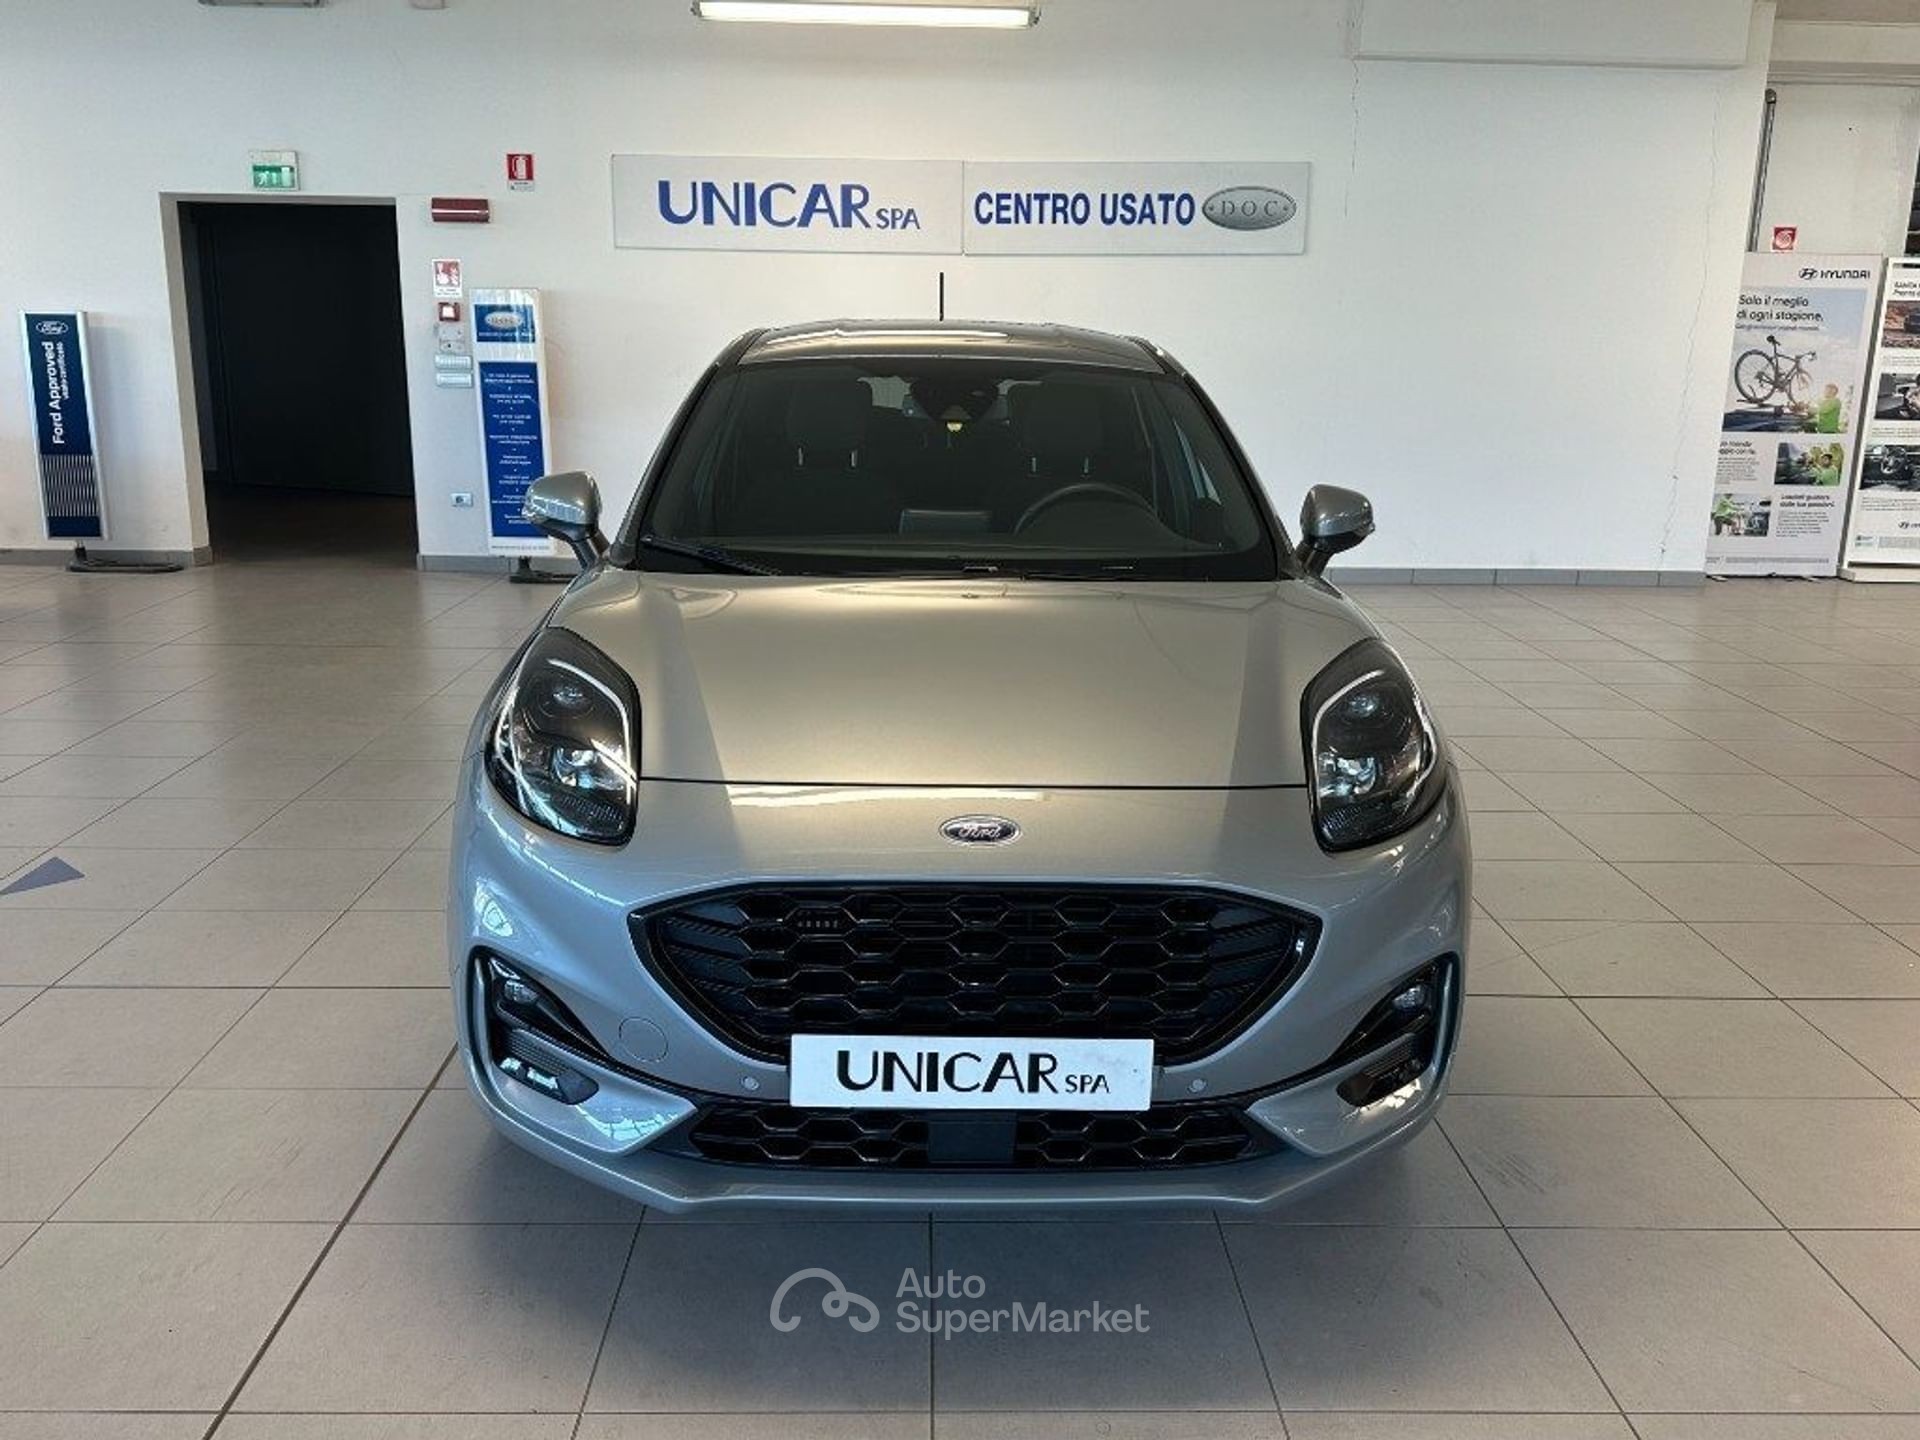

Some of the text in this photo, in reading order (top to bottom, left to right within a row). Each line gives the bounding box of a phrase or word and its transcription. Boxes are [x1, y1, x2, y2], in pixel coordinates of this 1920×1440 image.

[658, 180, 921, 230] UNICAR SPA
[974, 191, 1279, 226] CENTRO USATO DOC
[1820, 269, 1871, 279] HYUNDAI
[1736, 310, 1746, 319] di
[1749, 310, 1773, 321] ogni
[1738, 294, 1762, 306] Solo
[1772, 295, 1809, 308] meglio
[41, 341, 65, 444] Ford Approved
[837, 1050, 1111, 1094] UNICAR SPA
